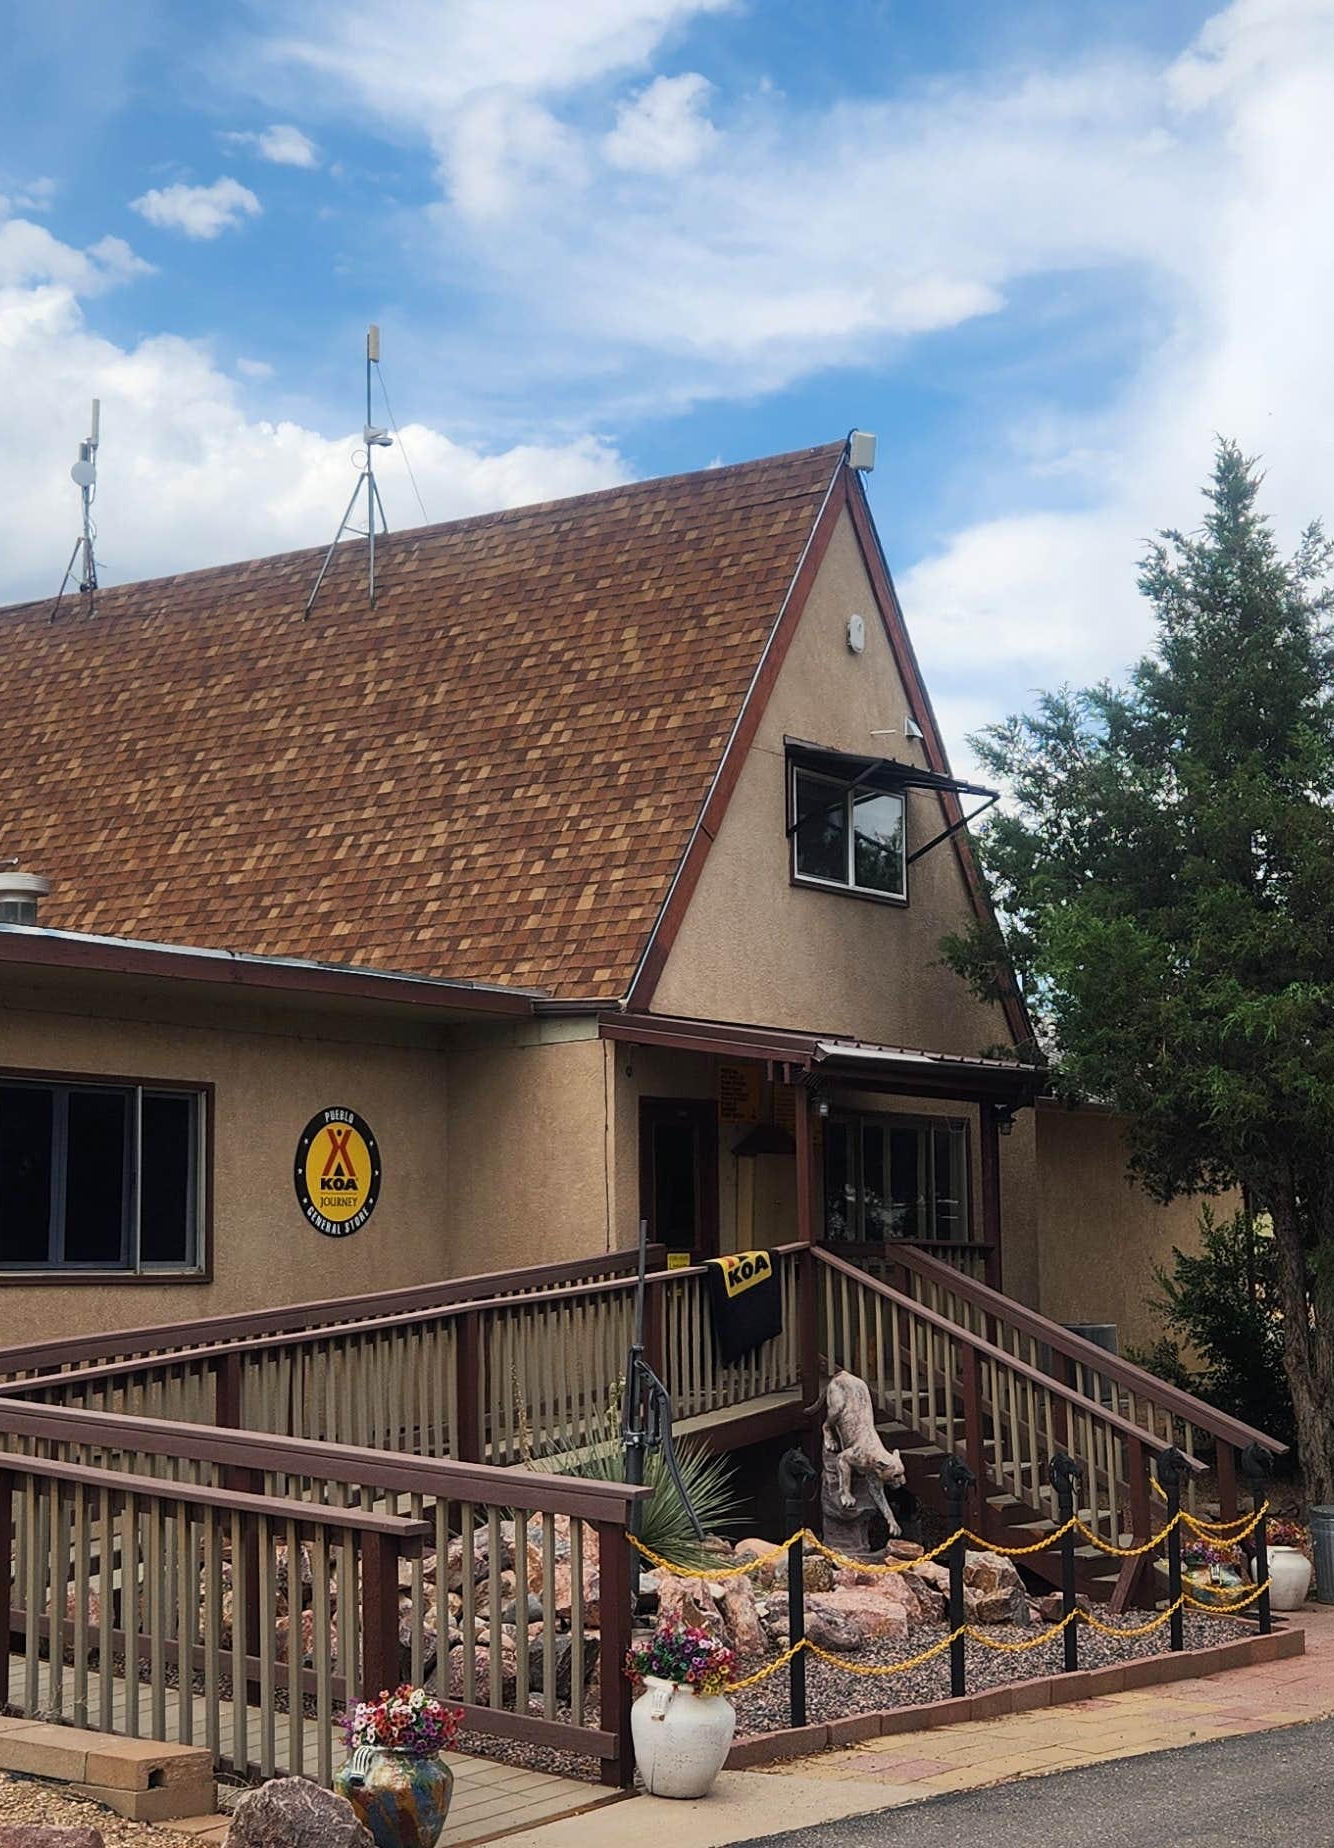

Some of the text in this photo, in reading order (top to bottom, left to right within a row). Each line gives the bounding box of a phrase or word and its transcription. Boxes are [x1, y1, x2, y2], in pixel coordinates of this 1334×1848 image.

[324, 1109, 354, 1124] PUEBLO
[320, 1178, 358, 1191] KOA
[320, 1197, 357, 1208] JOURNEY
[307, 1206, 369, 1235] GENERAL STORE
[728, 1254, 769, 1288] KOA
